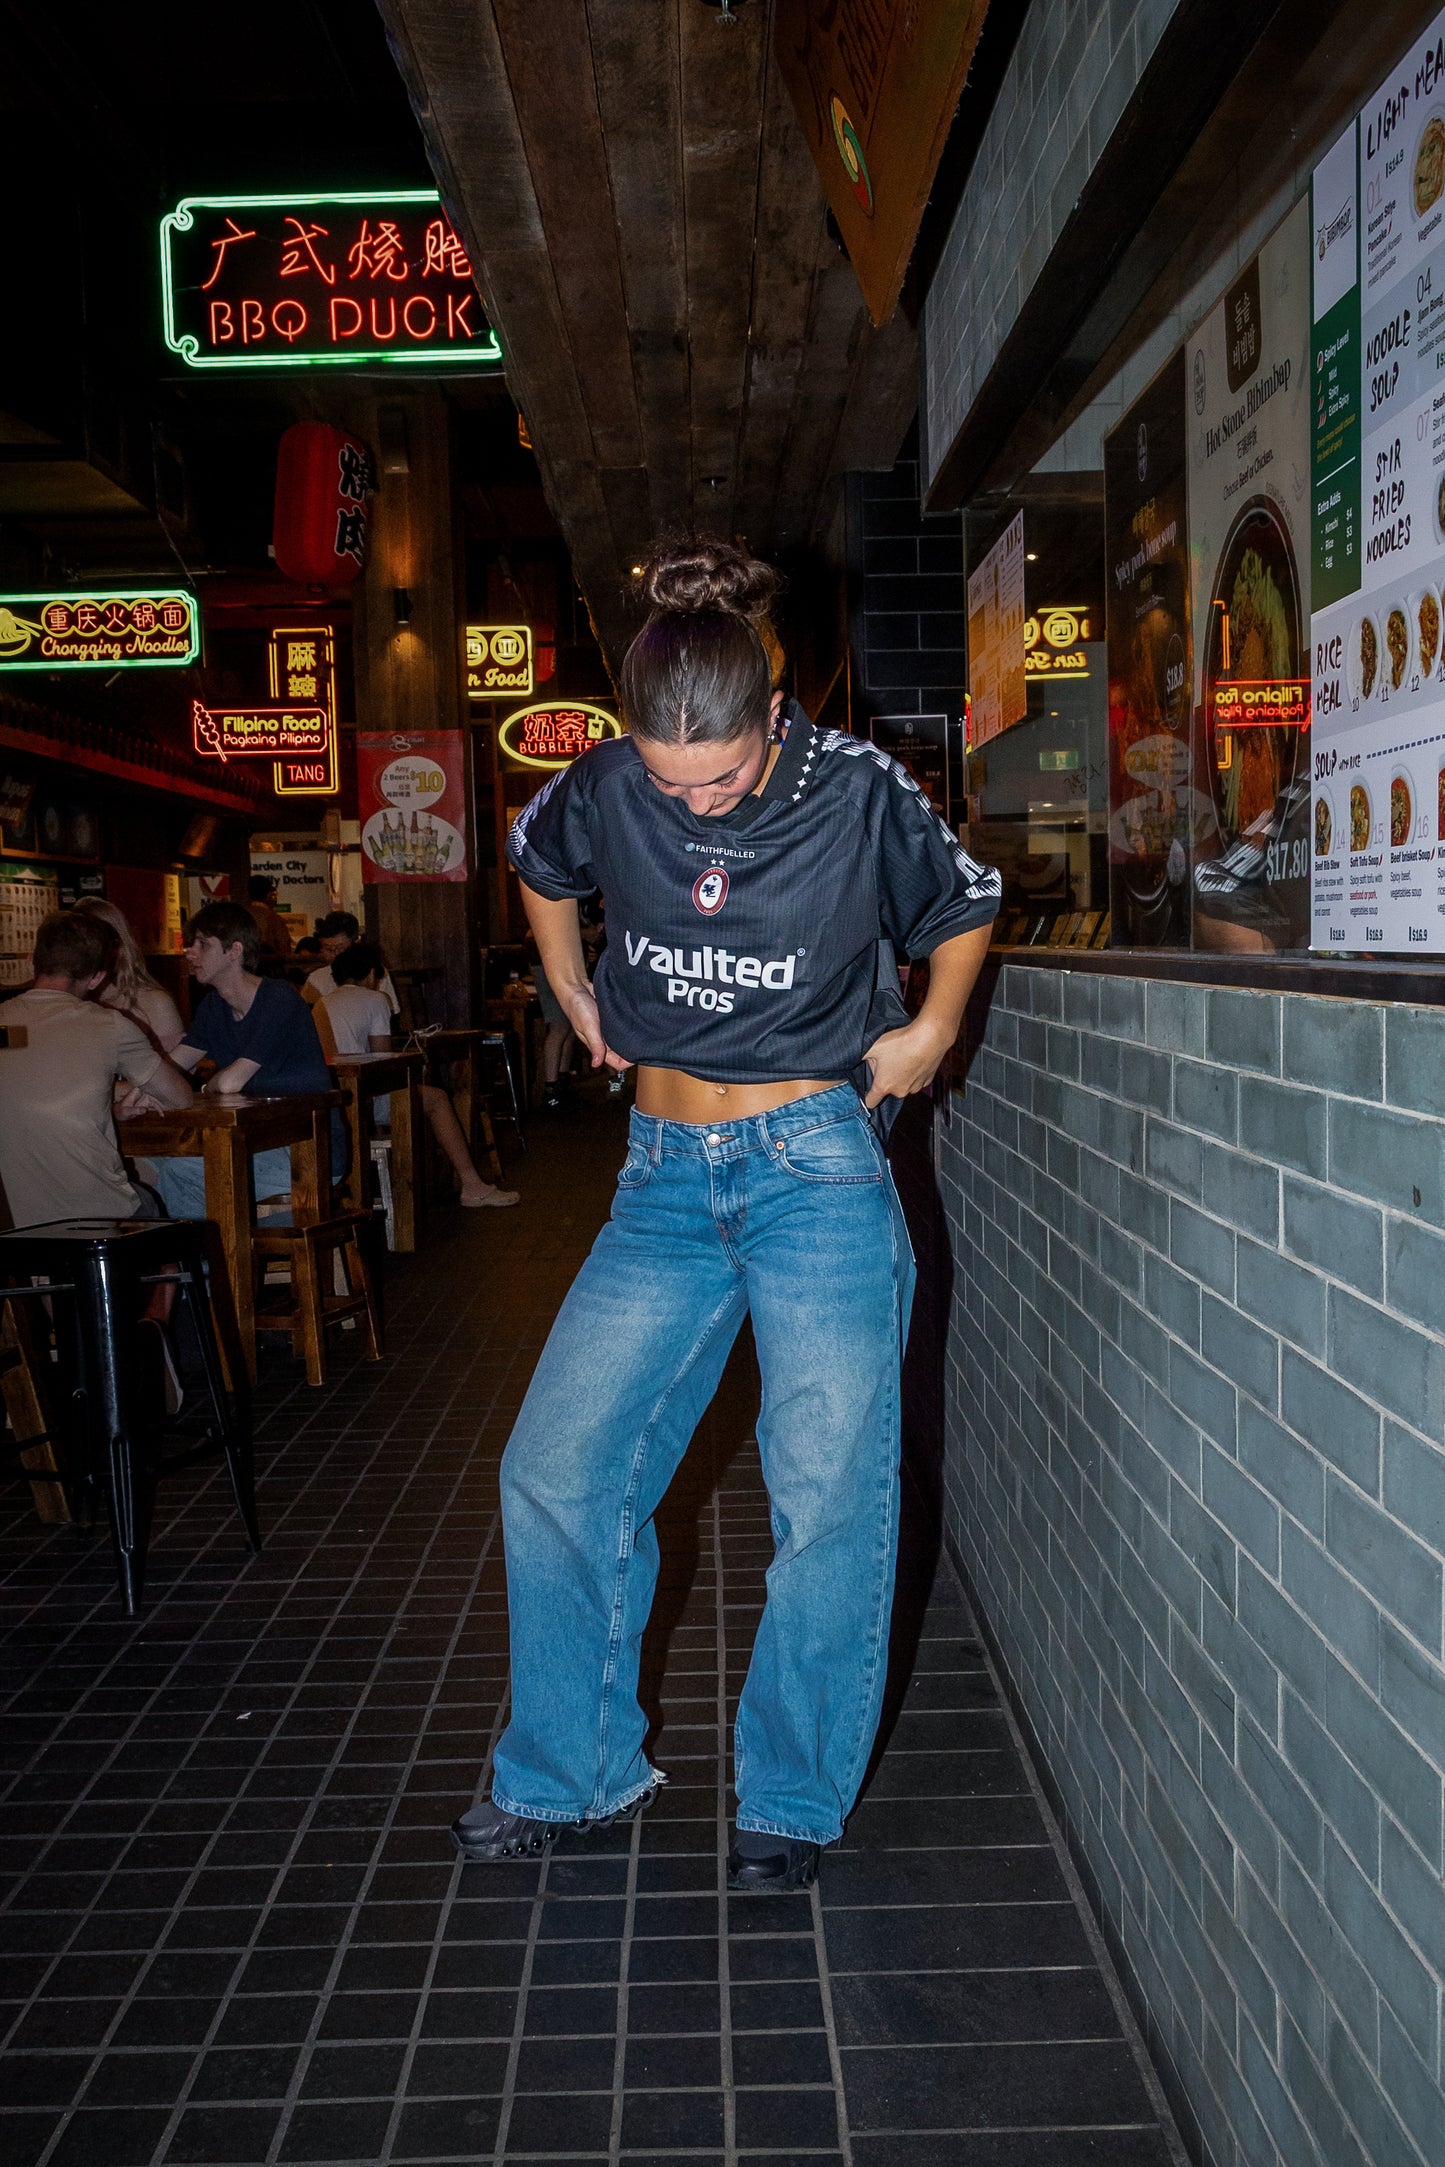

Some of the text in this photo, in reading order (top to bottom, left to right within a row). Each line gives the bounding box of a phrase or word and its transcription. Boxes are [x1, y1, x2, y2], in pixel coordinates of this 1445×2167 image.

[1367, 37, 1445, 160] LIGHT MEA
[1367, 172, 1382, 214] 01
[1416, 267, 1431, 303] 04
[210, 294, 473, 345] BBQ DUCK
[1366, 309, 1410, 370] NOODLE
[1370, 361, 1399, 412] SOUP
[1206, 428, 1221, 458] Hot
[1222, 405, 1246, 443] Stone
[1247, 359, 1291, 419] Bibimbap
[1416, 408, 1429, 441] 07
[1376, 438, 1401, 482] STIR
[1317, 498, 1329, 516] Extra
[1372, 480, 1404, 525] FRIED
[1367, 514, 1411, 564] NOODLES
[46, 603, 184, 632] 重庆火锅面
[41, 634, 190, 661] Chongqing Noodles
[1316, 635, 1342, 677] RICE
[484, 667, 529, 687] Food
[1410, 675, 1420, 692] 12
[1316, 680, 1342, 715] MEAL
[223, 715, 321, 734] Filipino Food
[223, 731, 321, 748] Pagkaing Pilipino
[524, 711, 586, 742] 奶茶
[519, 740, 599, 754] BUBBLE TE
[286, 764, 324, 783] TANG
[1314, 748, 1337, 781] SOUP
[1417, 815, 1429, 839] 16
[250, 860, 307, 873] arden City
[695, 844, 756, 859] FAITHFUELLED
[1266, 837, 1309, 886] $17.80
[1350, 857, 1359, 868] Soft
[1368, 855, 1379, 868] Soup
[1390, 852, 1401, 863] Beef
[1418, 848, 1431, 862] Soup
[283, 875, 325, 885] Doctors
[1412, 929, 1428, 942] $16.9
[667, 979, 735, 1013] Pros
